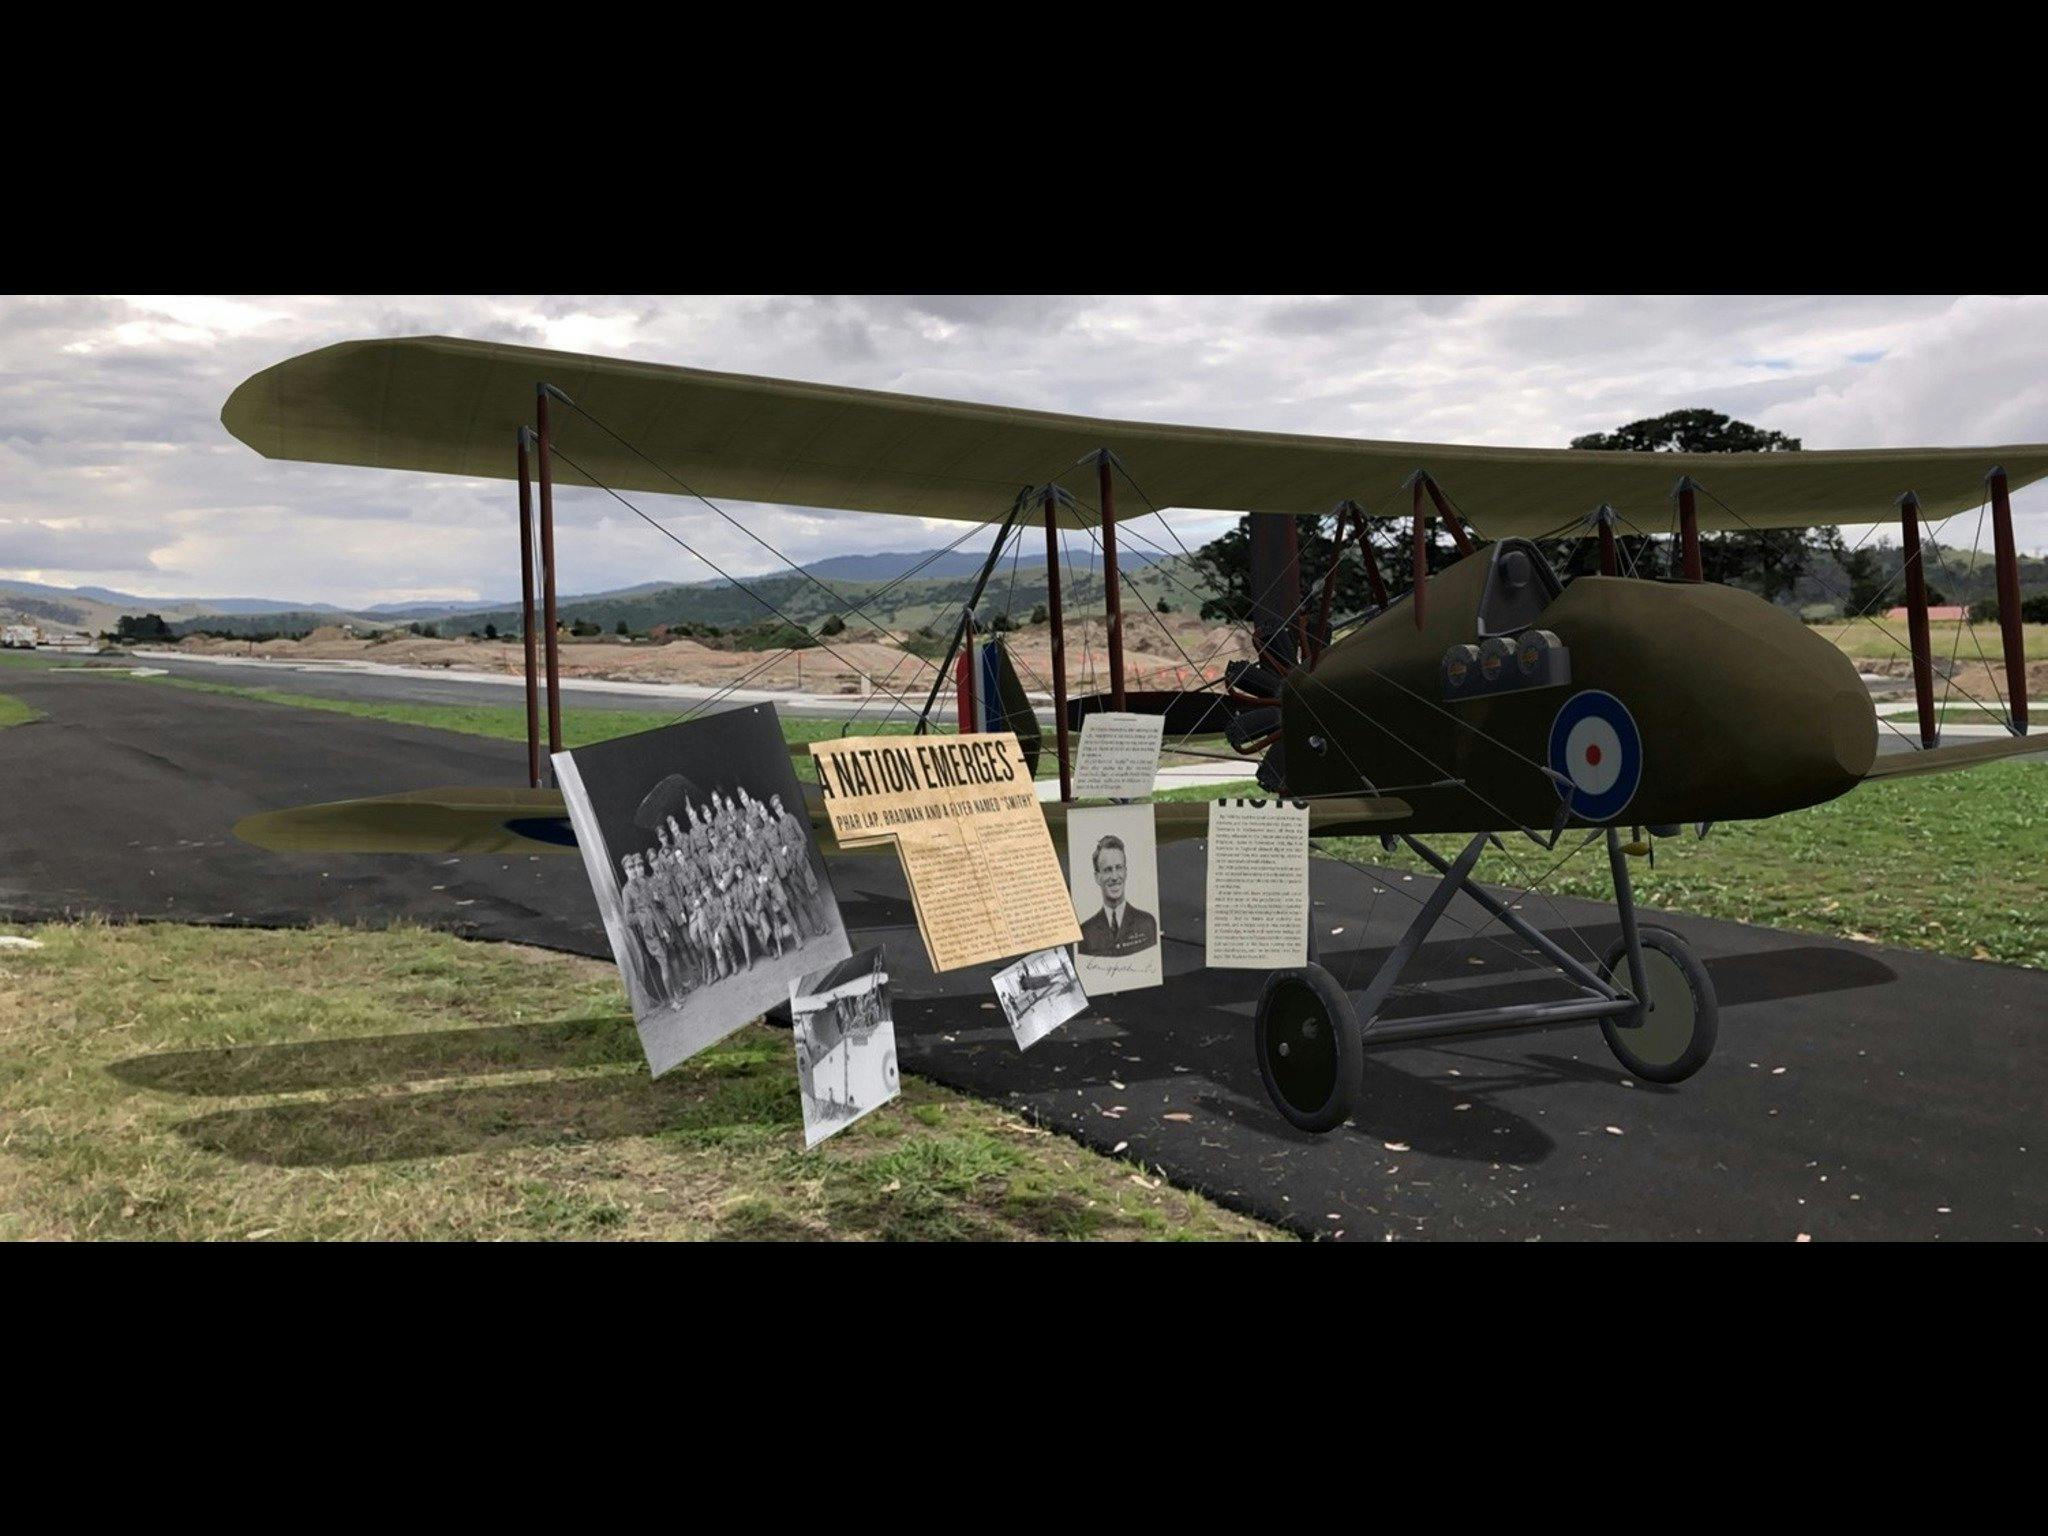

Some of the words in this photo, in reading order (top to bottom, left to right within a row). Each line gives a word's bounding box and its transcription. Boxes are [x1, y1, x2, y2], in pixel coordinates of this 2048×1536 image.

[813, 753, 835, 799] A
[831, 748, 921, 798] NATION
[916, 740, 1015, 789] EMERGES
[836, 813, 862, 831] PHAR
[882, 807, 925, 826] BRADMAN
[924, 804, 942, 820] AND
[942, 803, 949, 816] A
[973, 797, 1001, 814] NAMED
